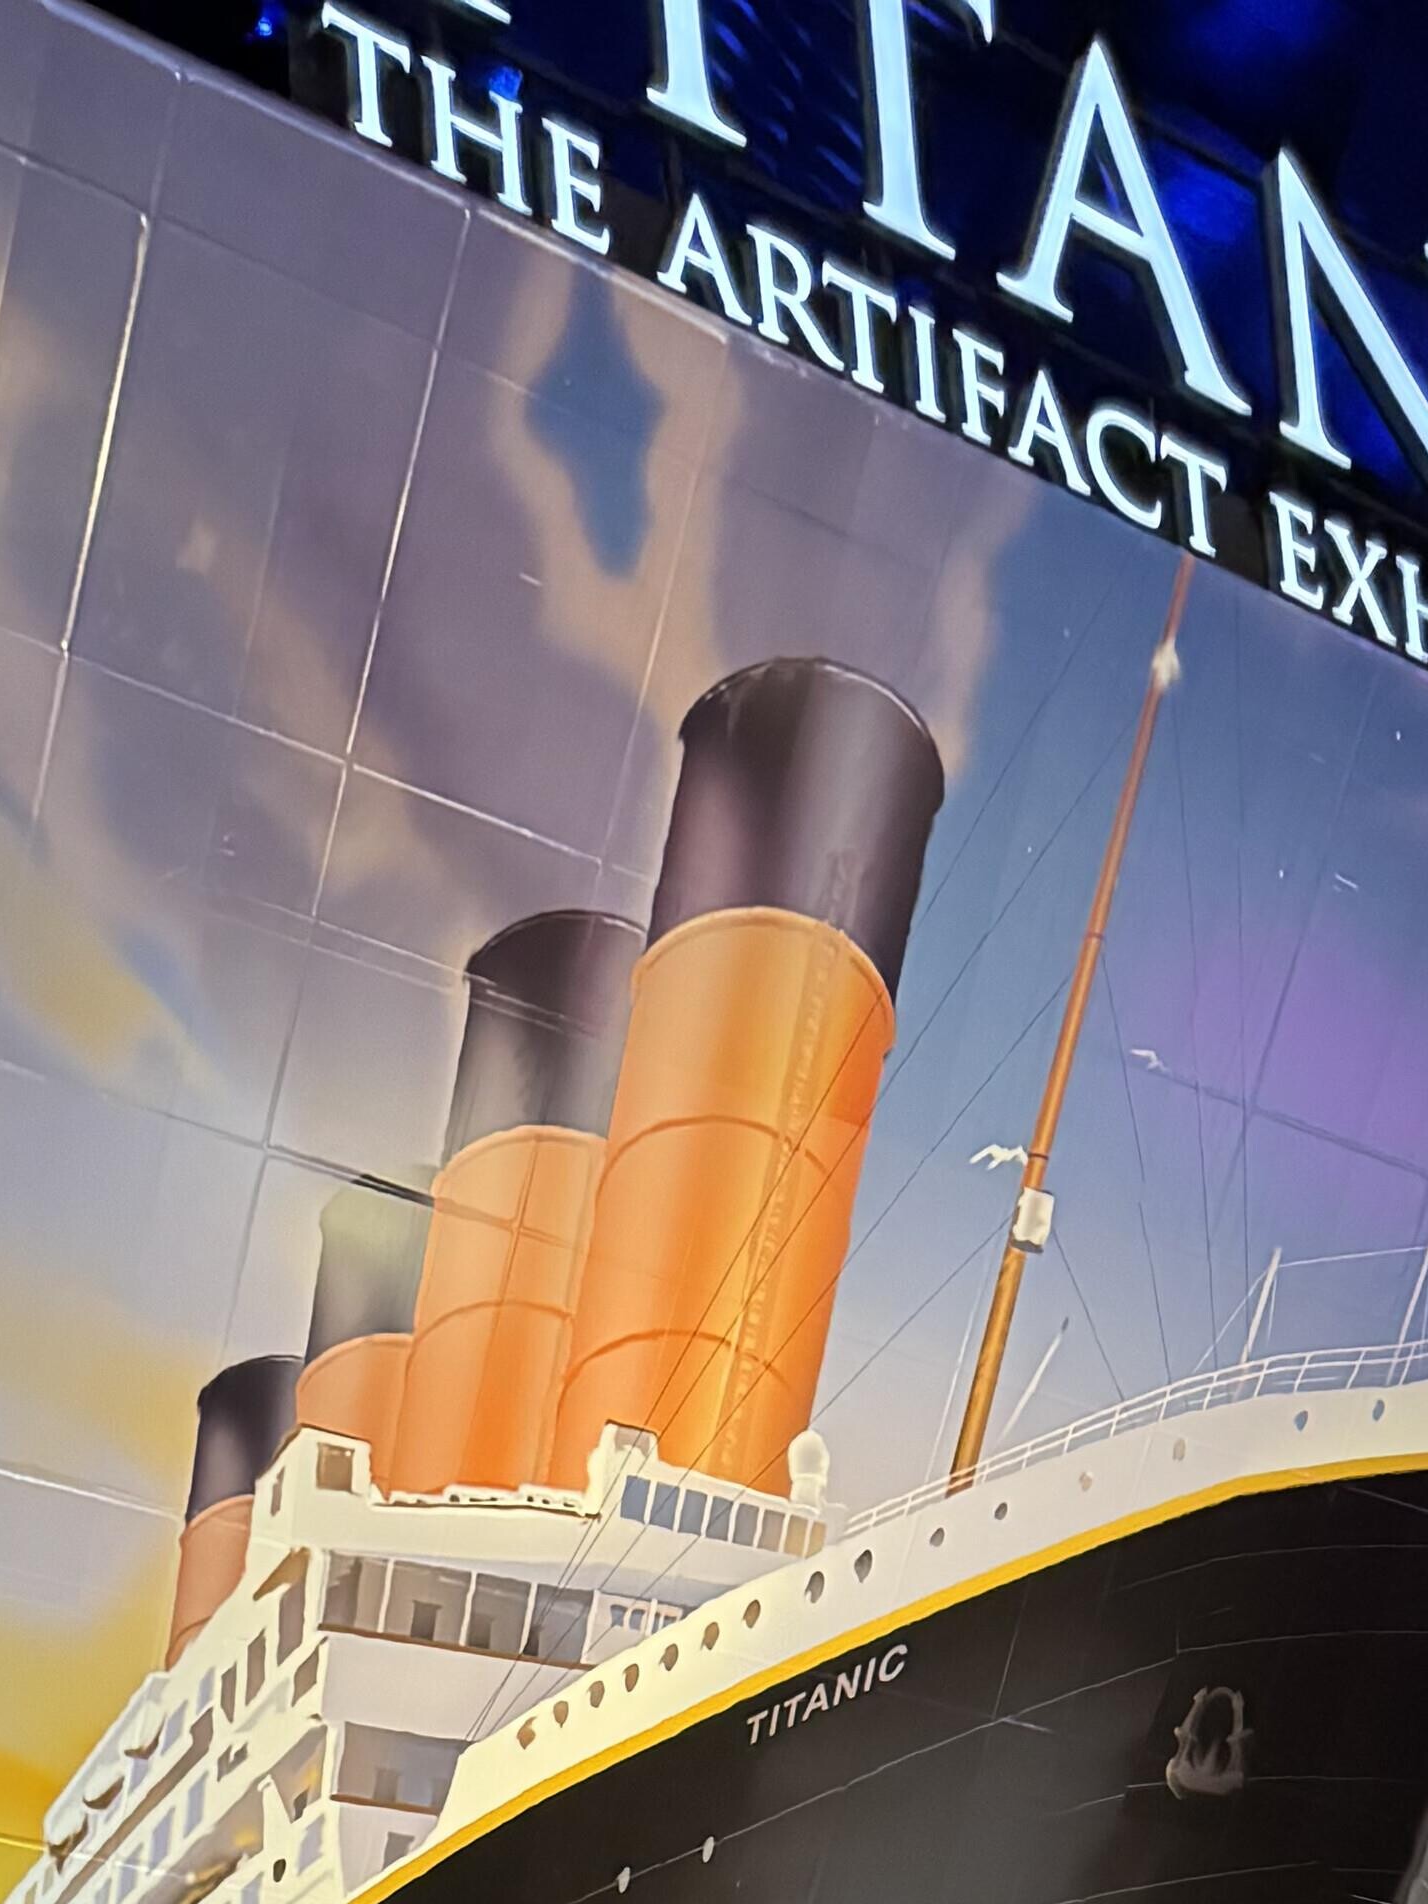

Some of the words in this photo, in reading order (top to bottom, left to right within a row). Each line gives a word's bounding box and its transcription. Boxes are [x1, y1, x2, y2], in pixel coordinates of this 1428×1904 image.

[322, 2, 610, 255] THE
[658, 193, 1228, 557] ARTIFACT
[746, 1643, 909, 1745] TITANIC
